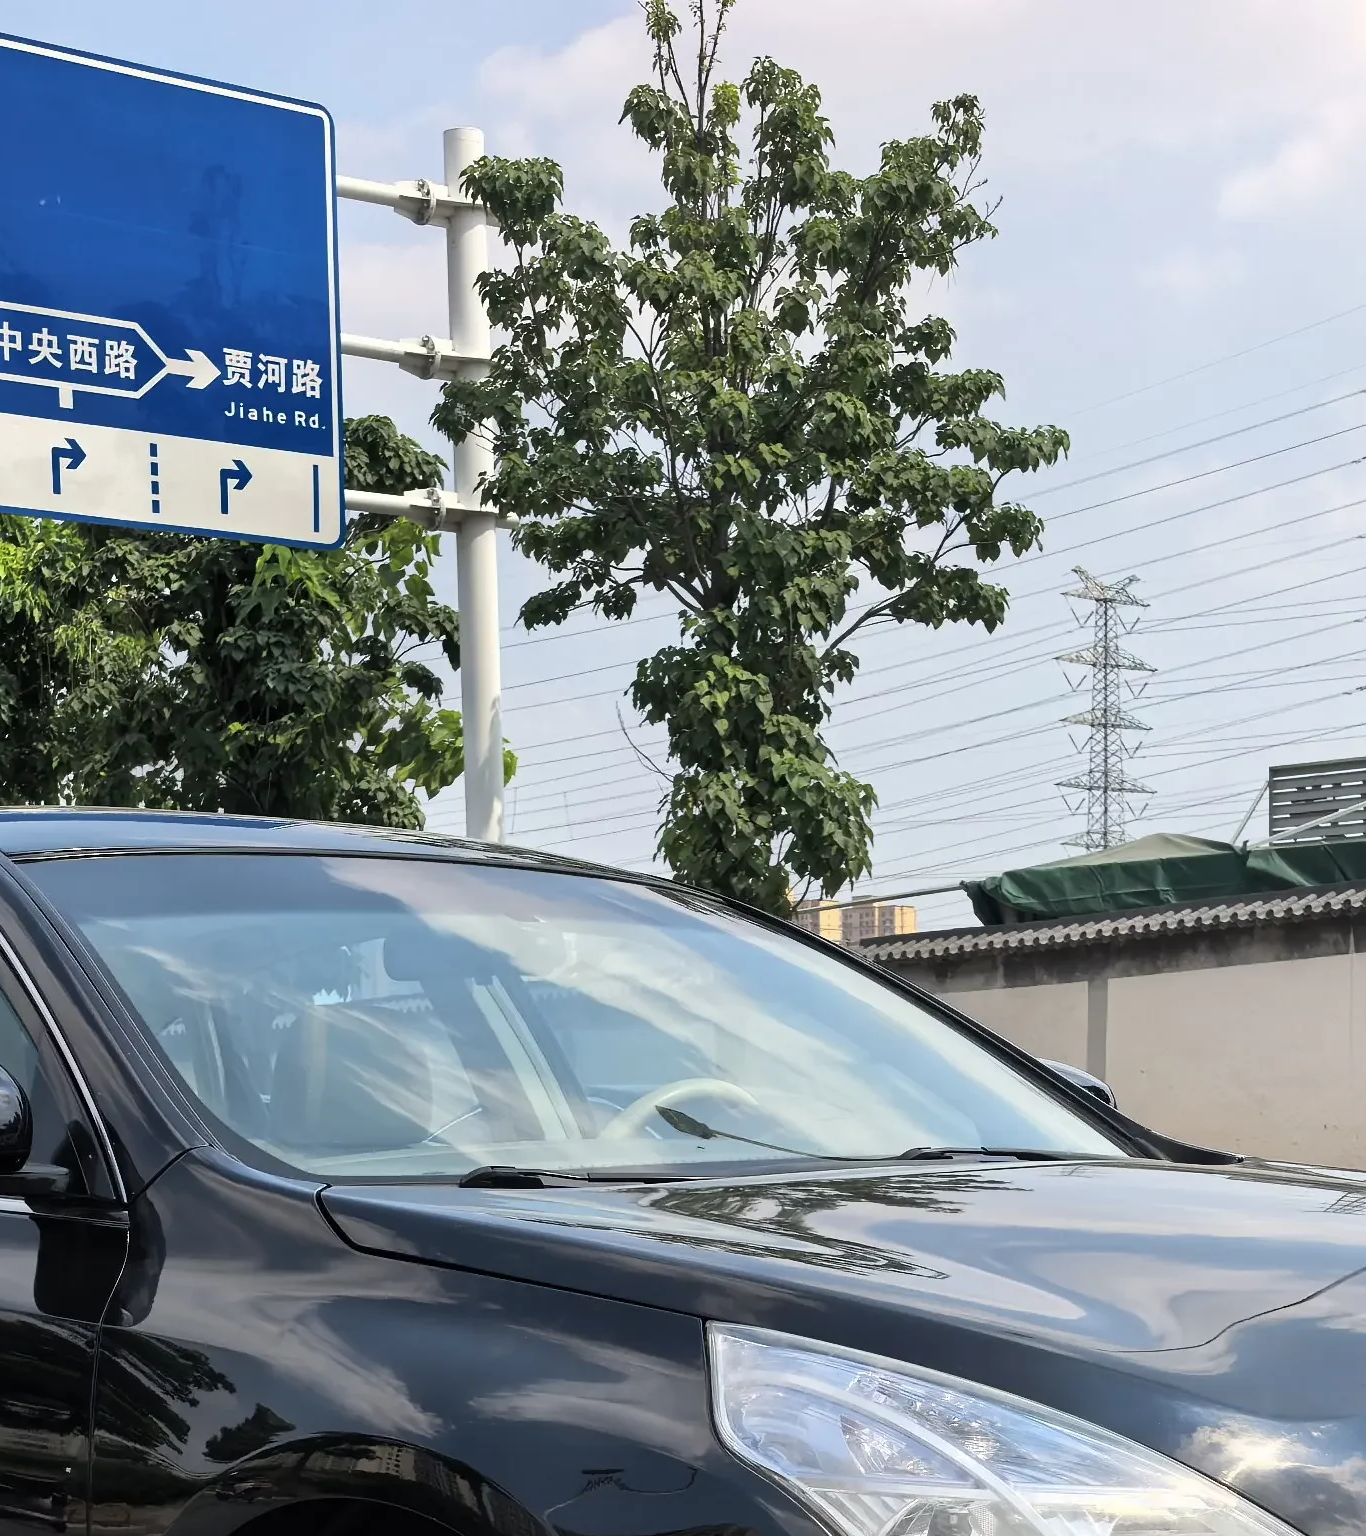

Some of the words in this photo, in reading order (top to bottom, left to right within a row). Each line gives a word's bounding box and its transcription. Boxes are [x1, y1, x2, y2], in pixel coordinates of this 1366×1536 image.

[222, 348, 324, 399] 贾河路
[224, 402, 288, 425] Jiahe
[294, 411, 327, 430] Rd.
